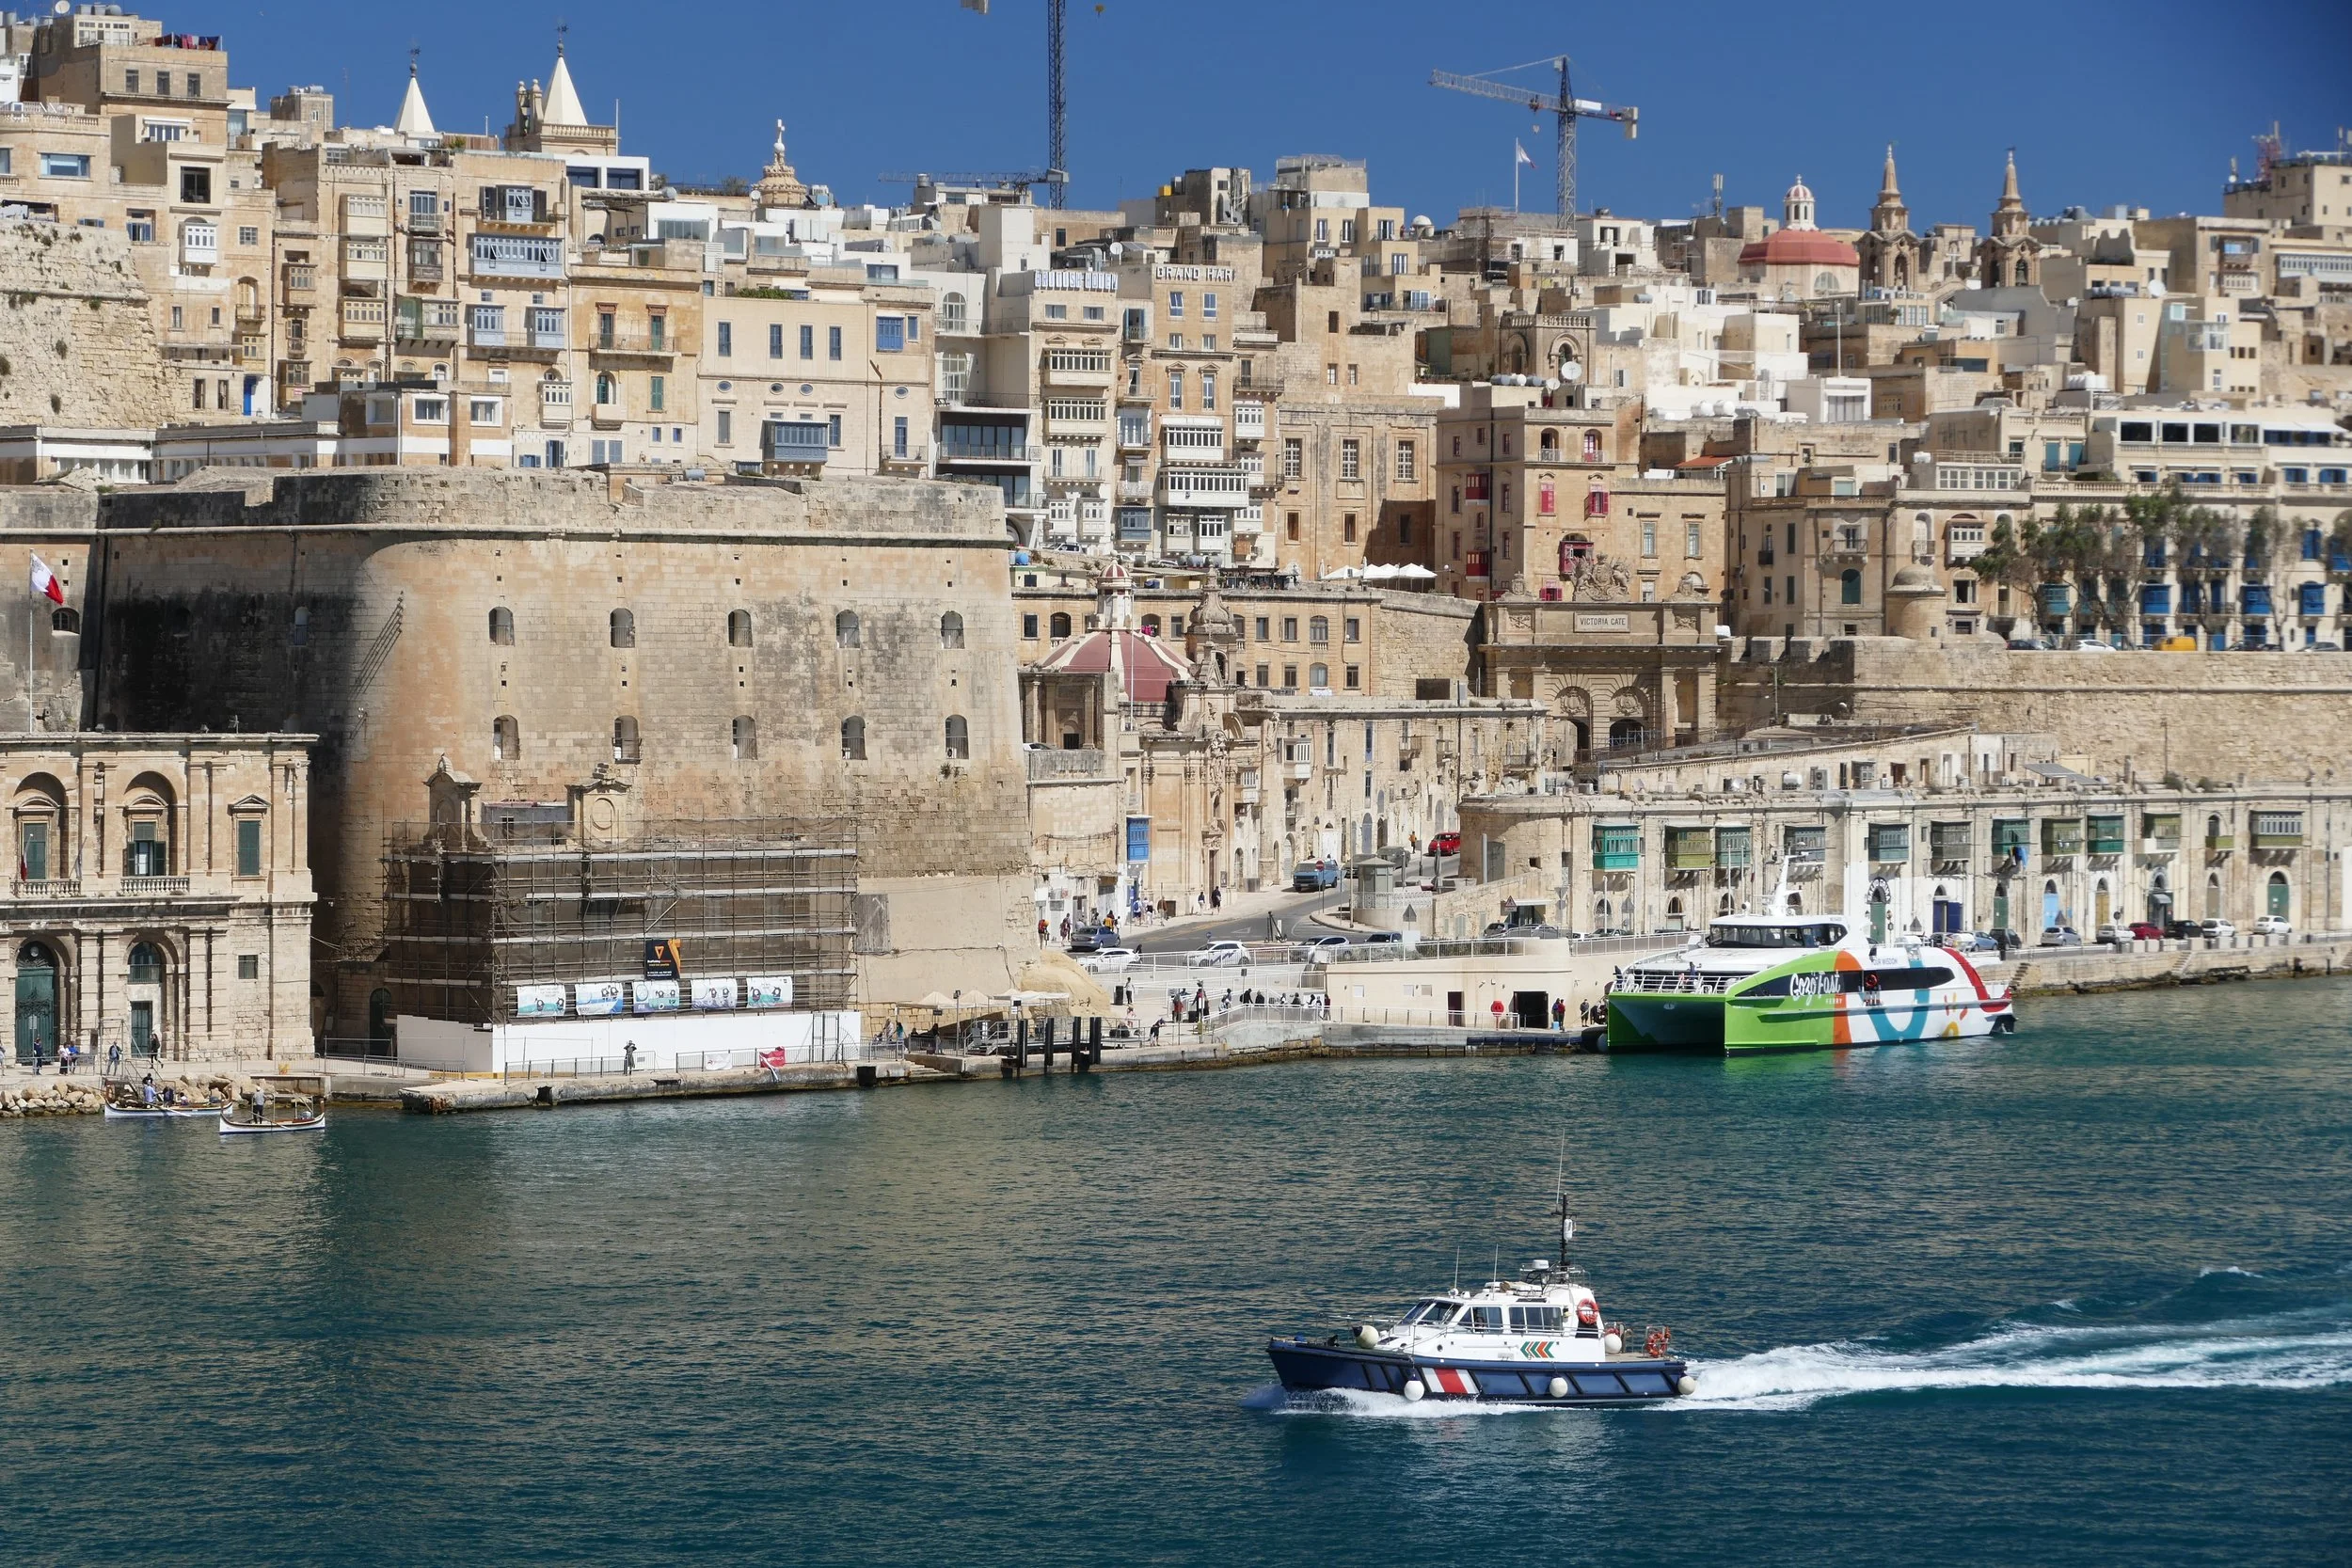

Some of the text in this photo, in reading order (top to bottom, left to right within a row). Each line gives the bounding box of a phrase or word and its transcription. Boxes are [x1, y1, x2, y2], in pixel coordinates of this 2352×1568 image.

[1035, 269, 1082, 287] BRITISH
[1156, 266, 1200, 280] GRAND
[1581, 617, 1609, 626] VICTORIA
[1790, 969, 1841, 1006] Gozo Fast
